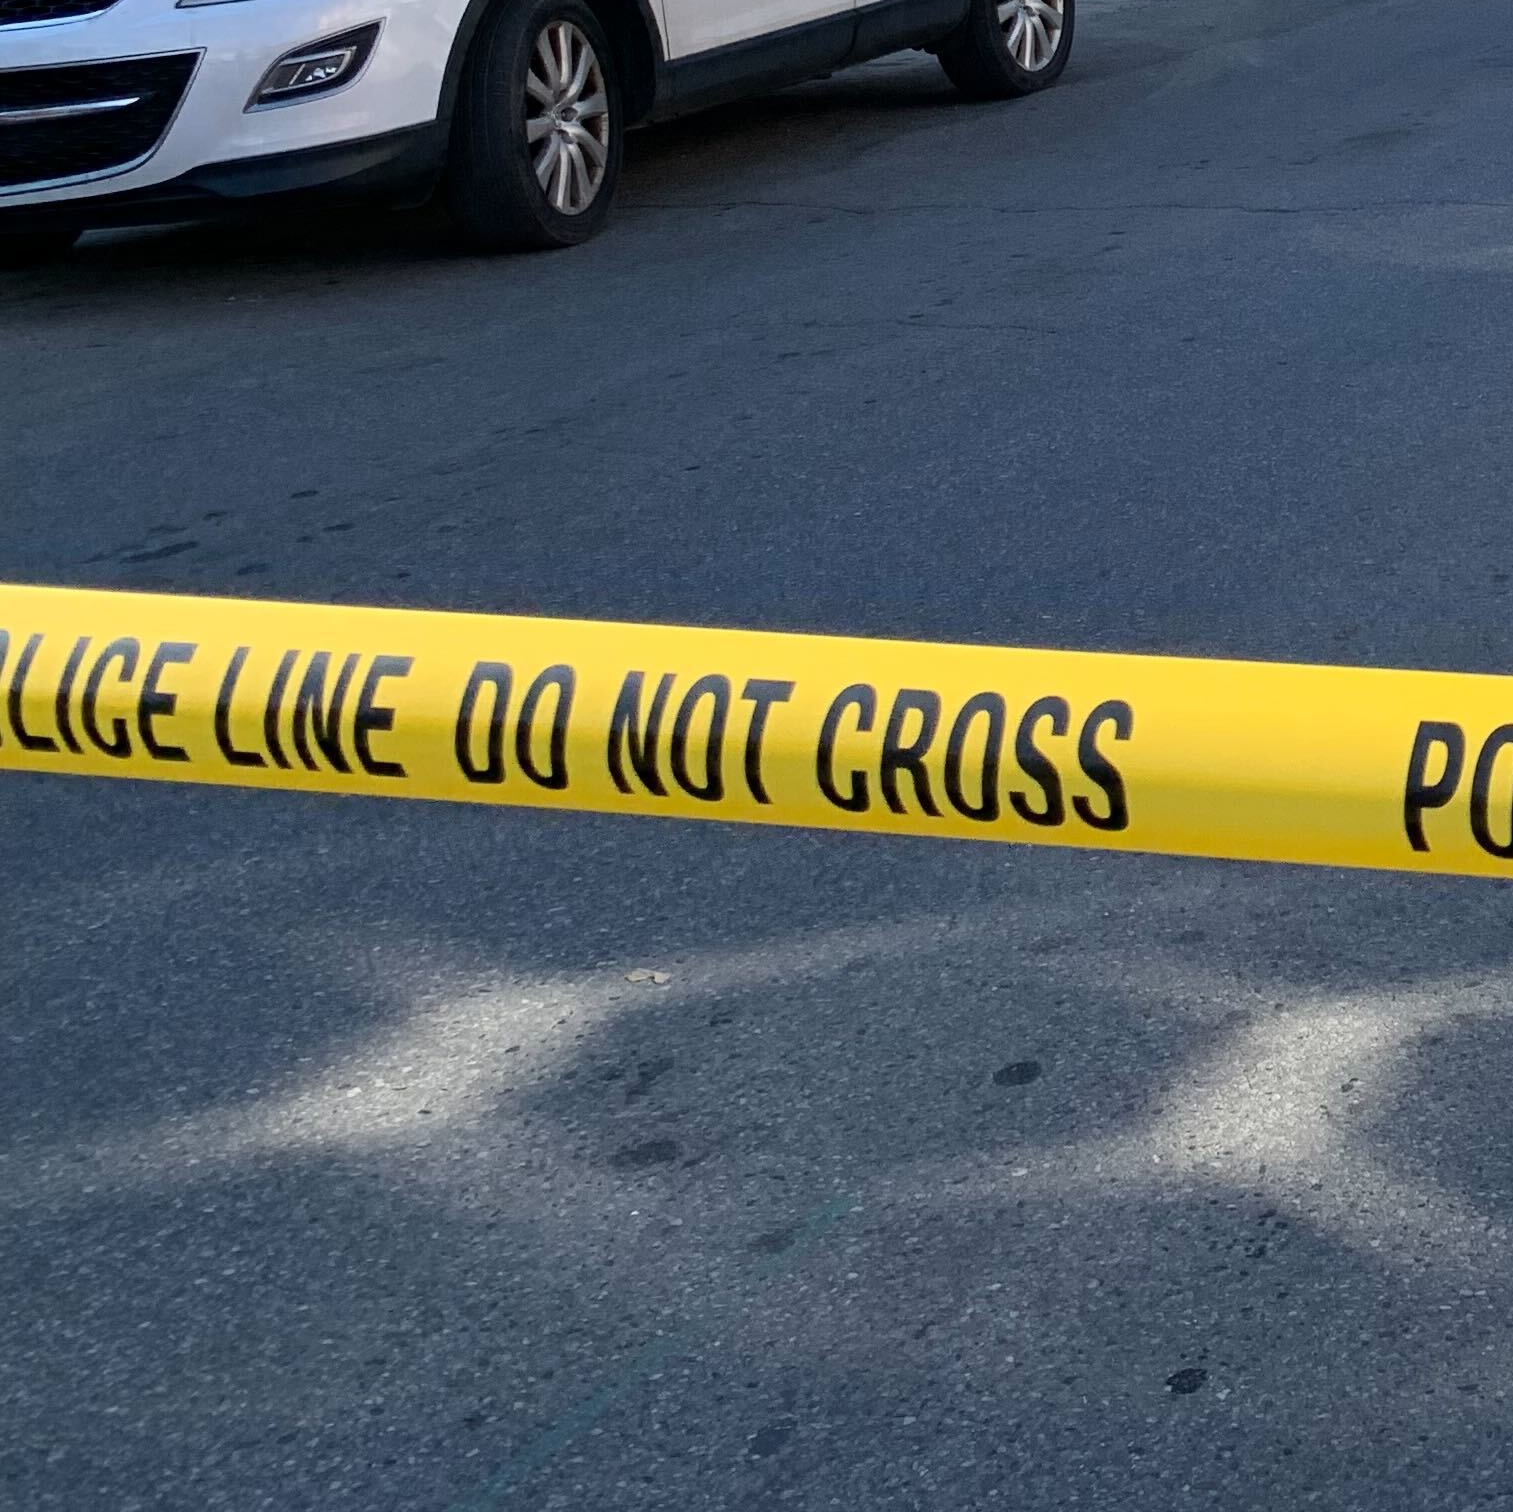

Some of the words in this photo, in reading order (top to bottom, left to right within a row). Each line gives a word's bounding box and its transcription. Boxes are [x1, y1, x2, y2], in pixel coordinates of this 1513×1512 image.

[0, 628, 199, 762] LICE
[213, 645, 412, 777] LINE
[455, 661, 576, 791] DO
[607, 670, 795, 805] NOT
[815, 683, 1134, 831] CROSS
